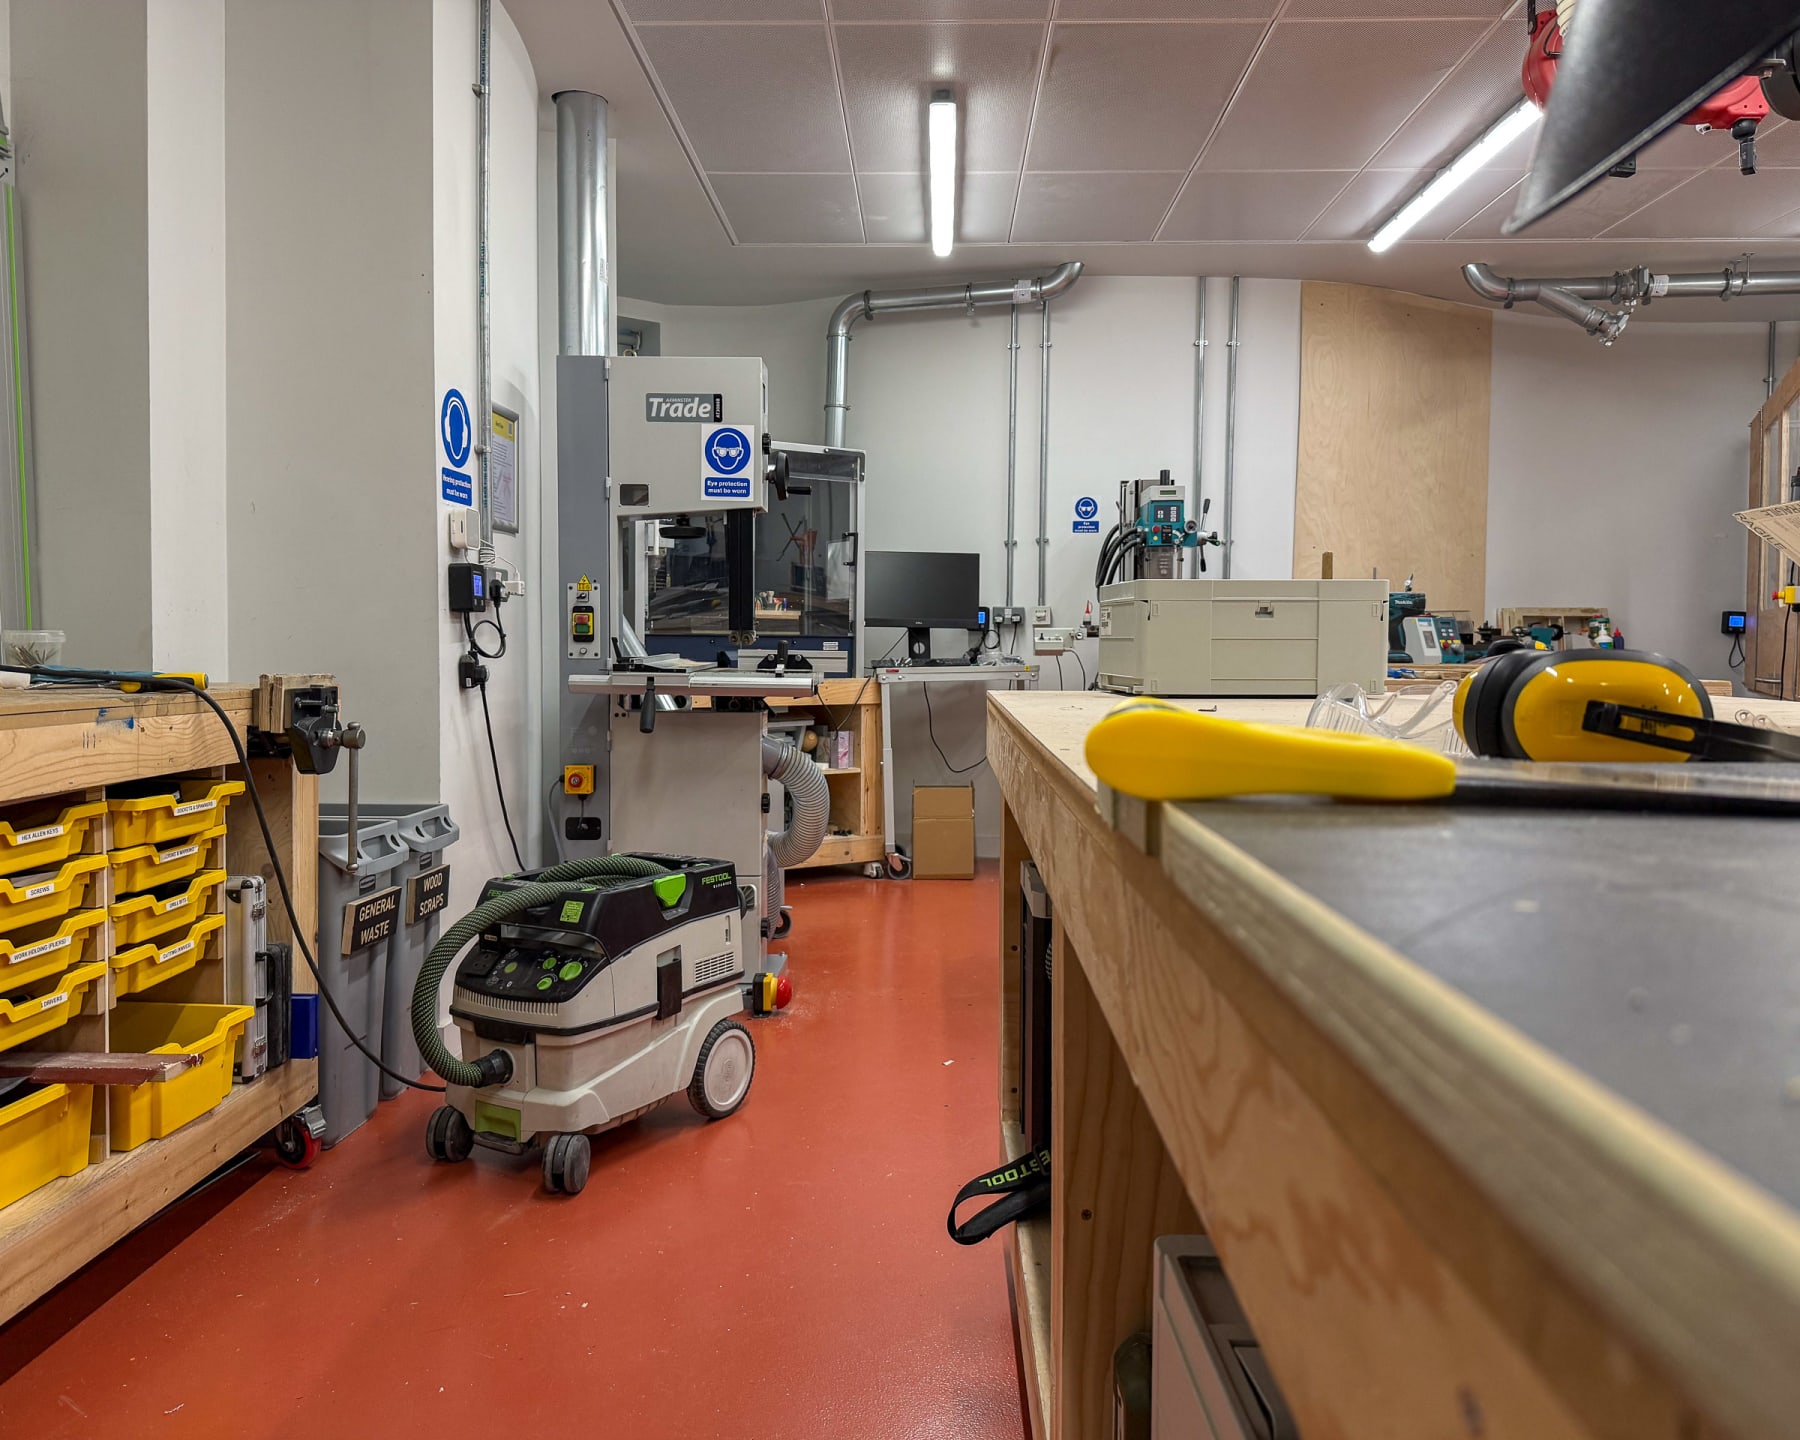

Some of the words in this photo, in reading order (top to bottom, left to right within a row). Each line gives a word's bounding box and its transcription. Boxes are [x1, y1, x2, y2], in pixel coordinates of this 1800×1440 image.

[649, 397, 711, 418] Trade
[32, 830, 46, 838] ALLEN
[424, 872, 443, 892] WOOD
[702, 872, 732, 885] FESTOOL
[30, 886, 50, 896] SCREWS
[360, 895, 396, 922] GENERAL
[420, 892, 444, 916] SCRAPS
[360, 920, 390, 945] WASTE
[14, 952, 28, 960] WORK
